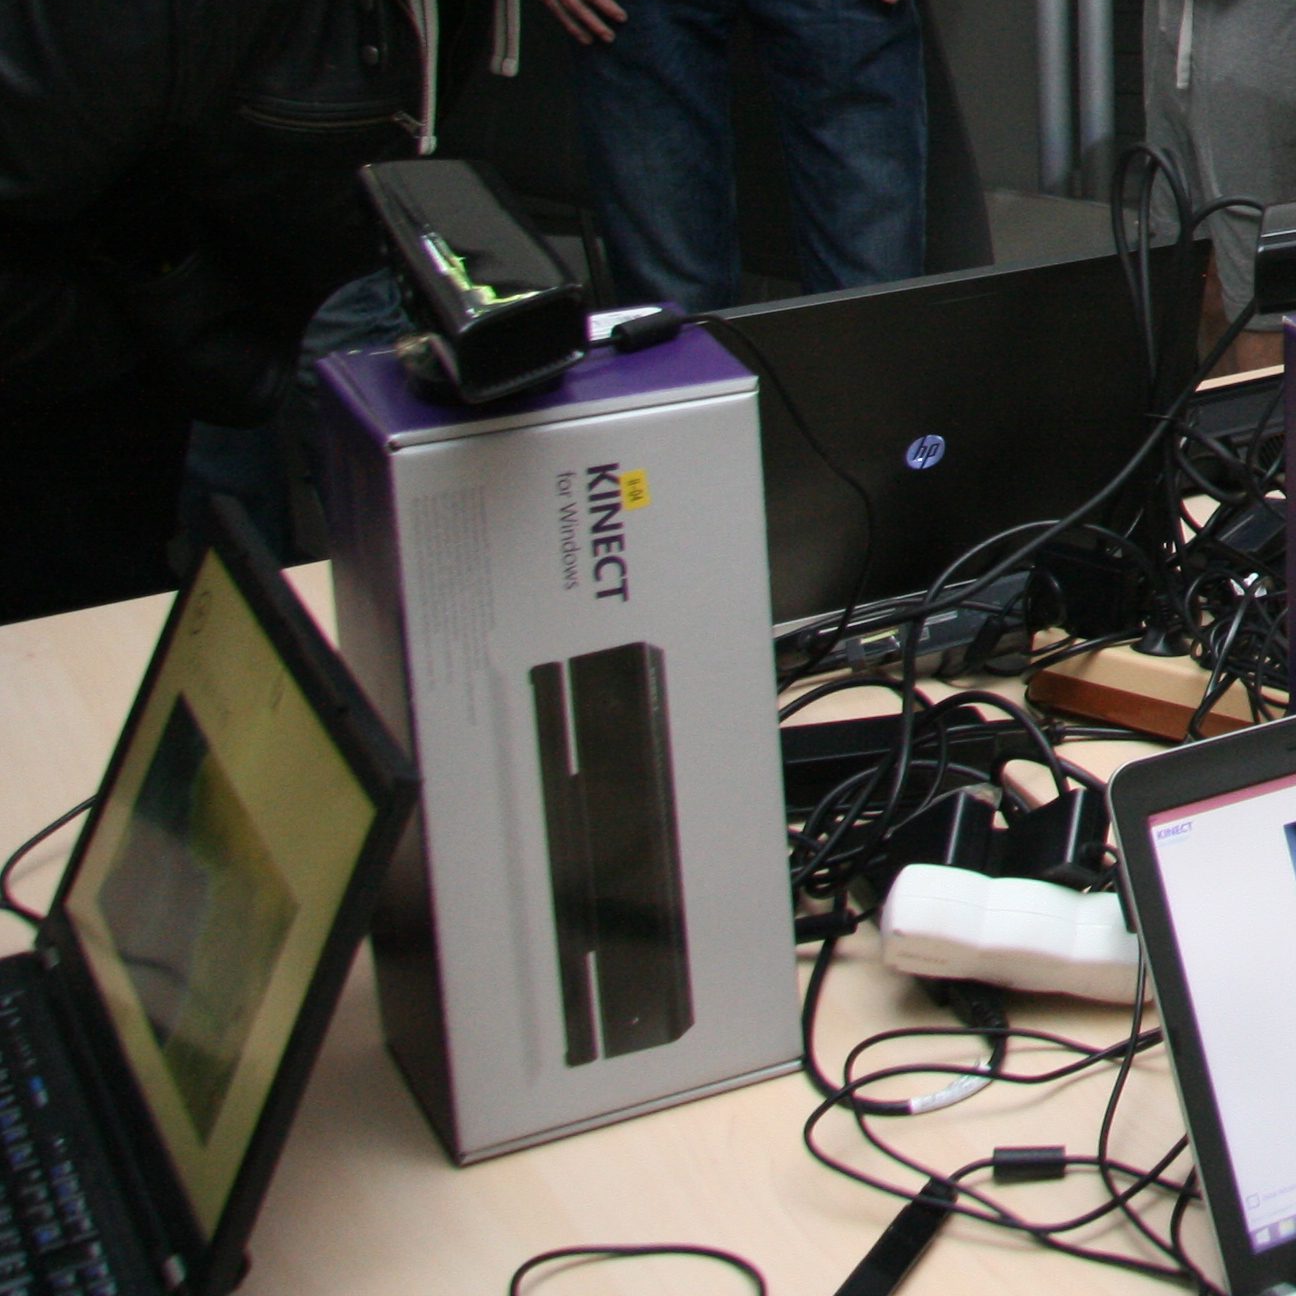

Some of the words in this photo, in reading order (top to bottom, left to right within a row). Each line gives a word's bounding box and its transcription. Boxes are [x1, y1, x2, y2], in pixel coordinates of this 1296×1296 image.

[555, 470, 577, 498] for
[908, 435, 944, 470] hp
[558, 501, 582, 592] Windows
[586, 461, 630, 603] KINECT
